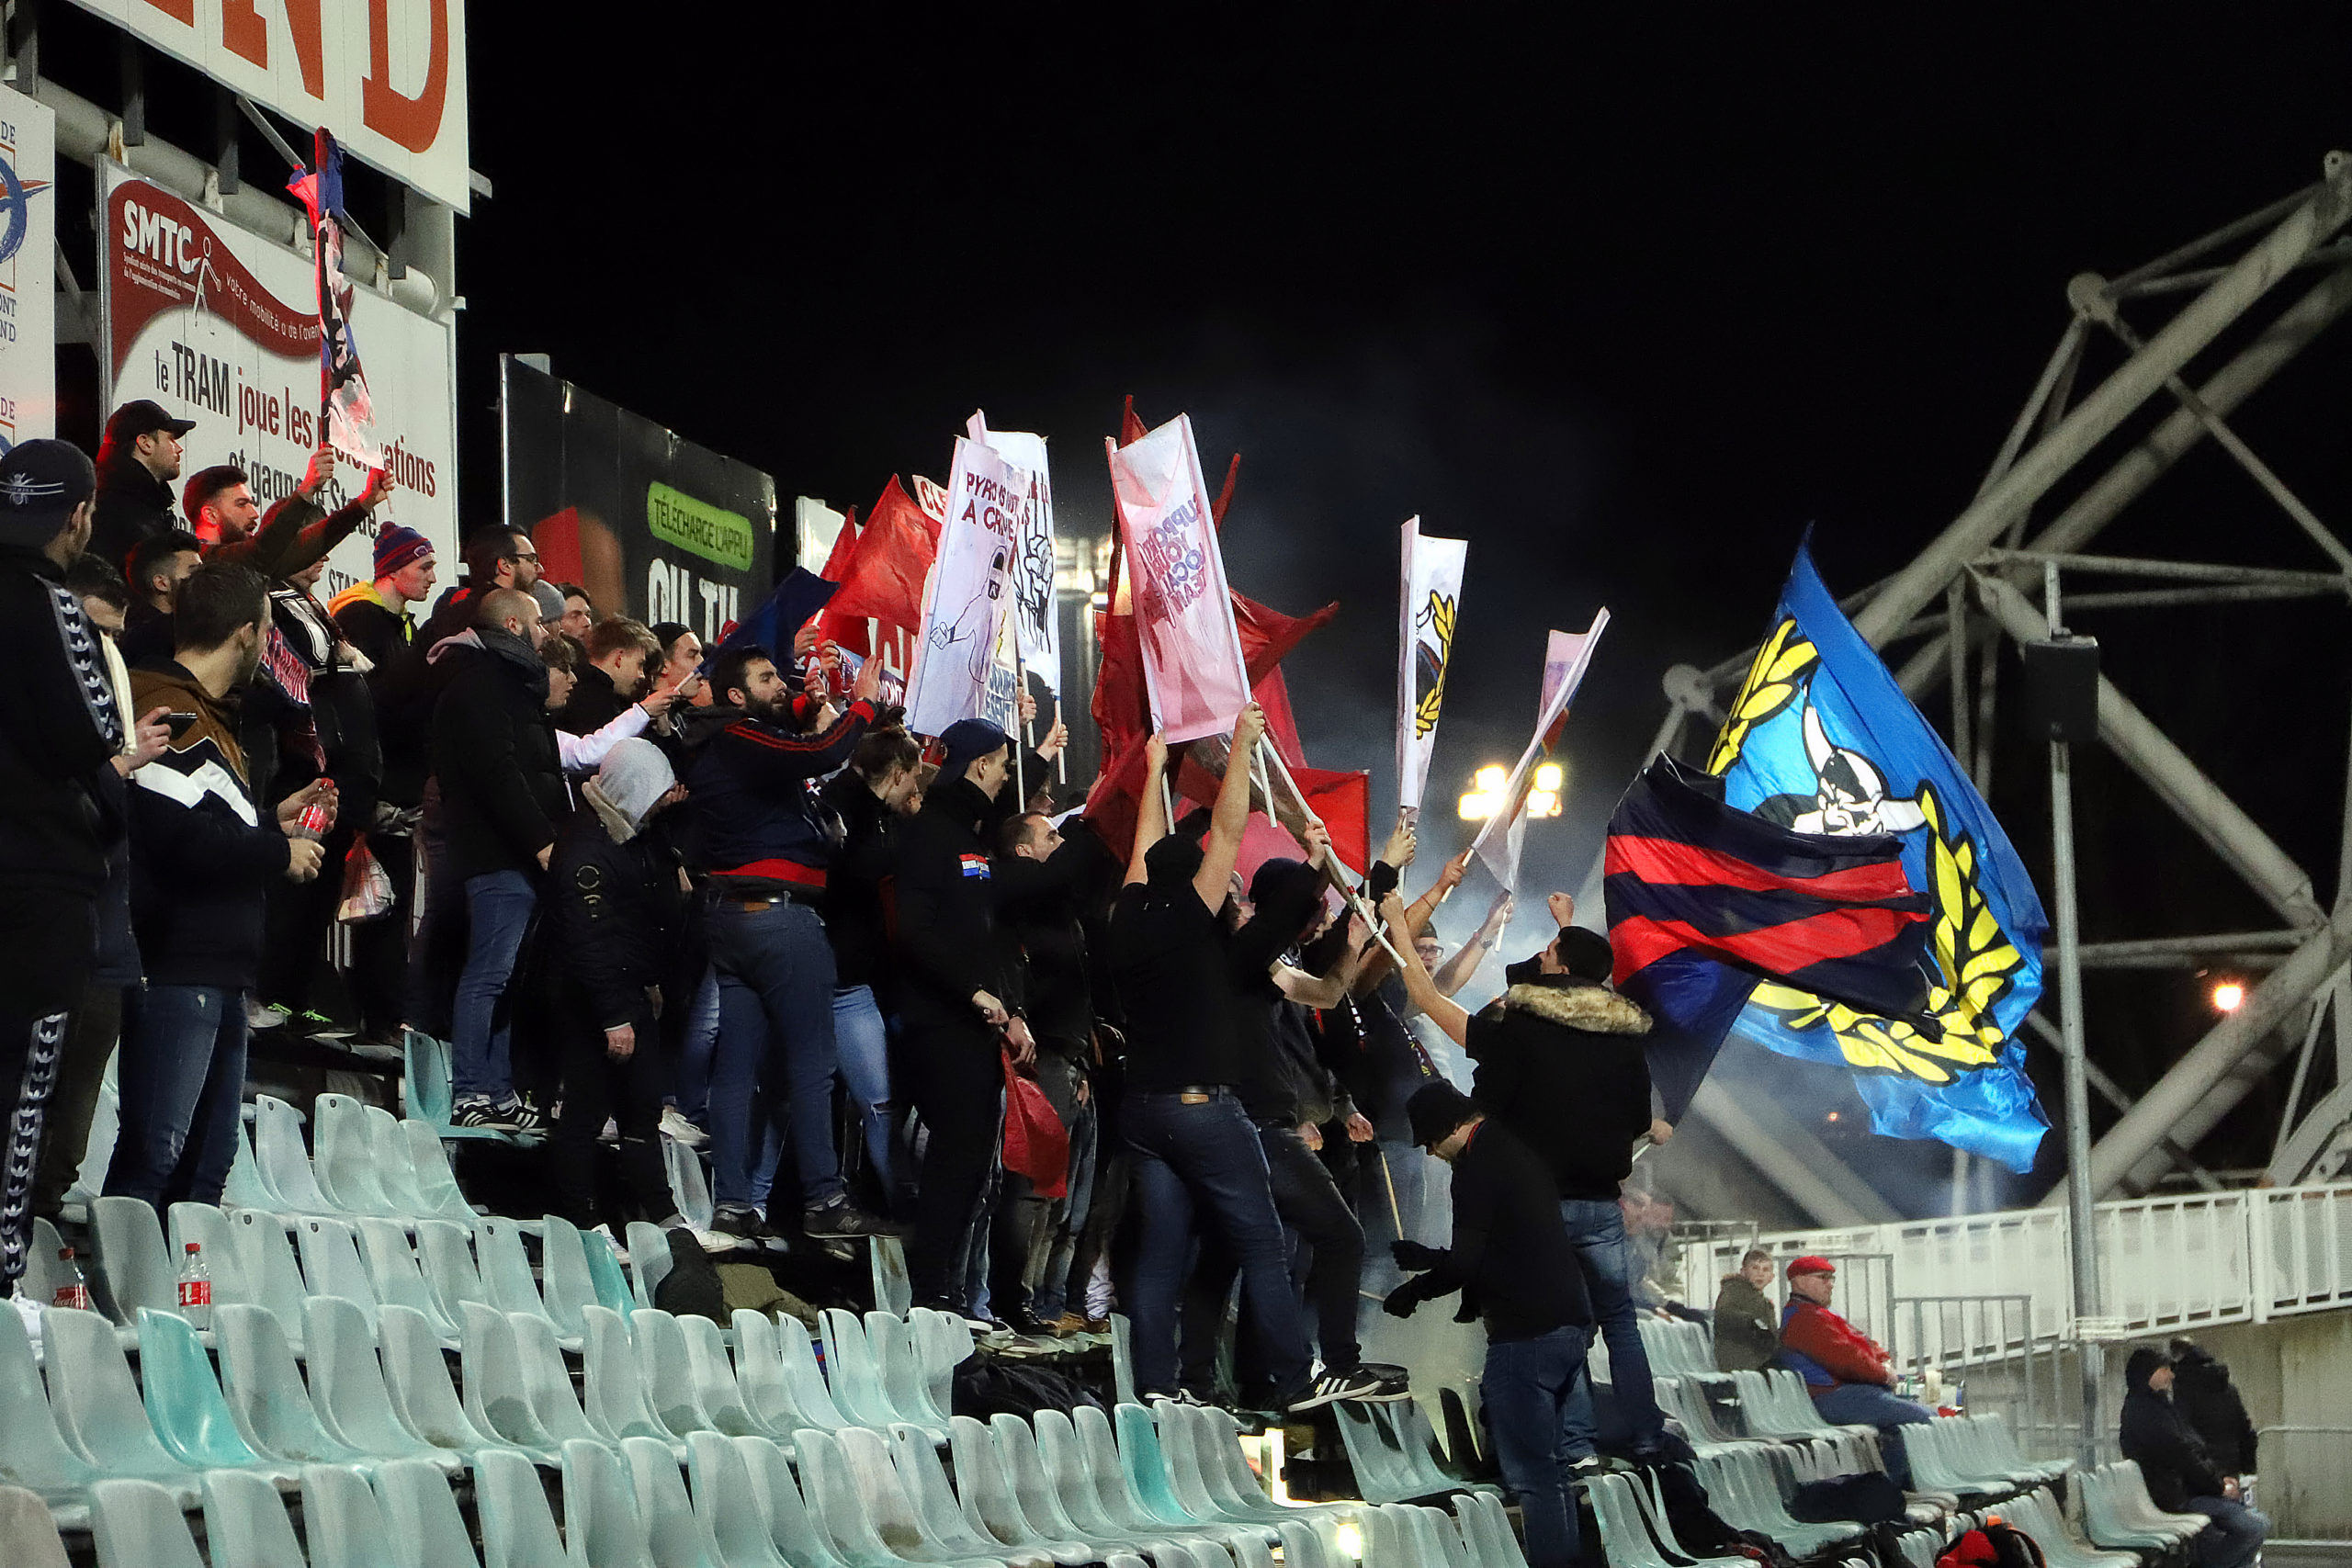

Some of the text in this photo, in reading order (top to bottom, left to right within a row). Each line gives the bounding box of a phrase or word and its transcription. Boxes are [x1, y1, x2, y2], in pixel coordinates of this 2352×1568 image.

[1, 120, 16, 145] DE
[123, 199, 201, 275] SMTC
[299, 319, 321, 340] l'aveni
[155, 340, 312, 449] le TRAM joue les
[966, 471, 998, 502] PYRO
[998, 484, 1007, 507] IS
[961, 498, 1014, 542] A CRIME
[328, 568, 360, 599] STA
